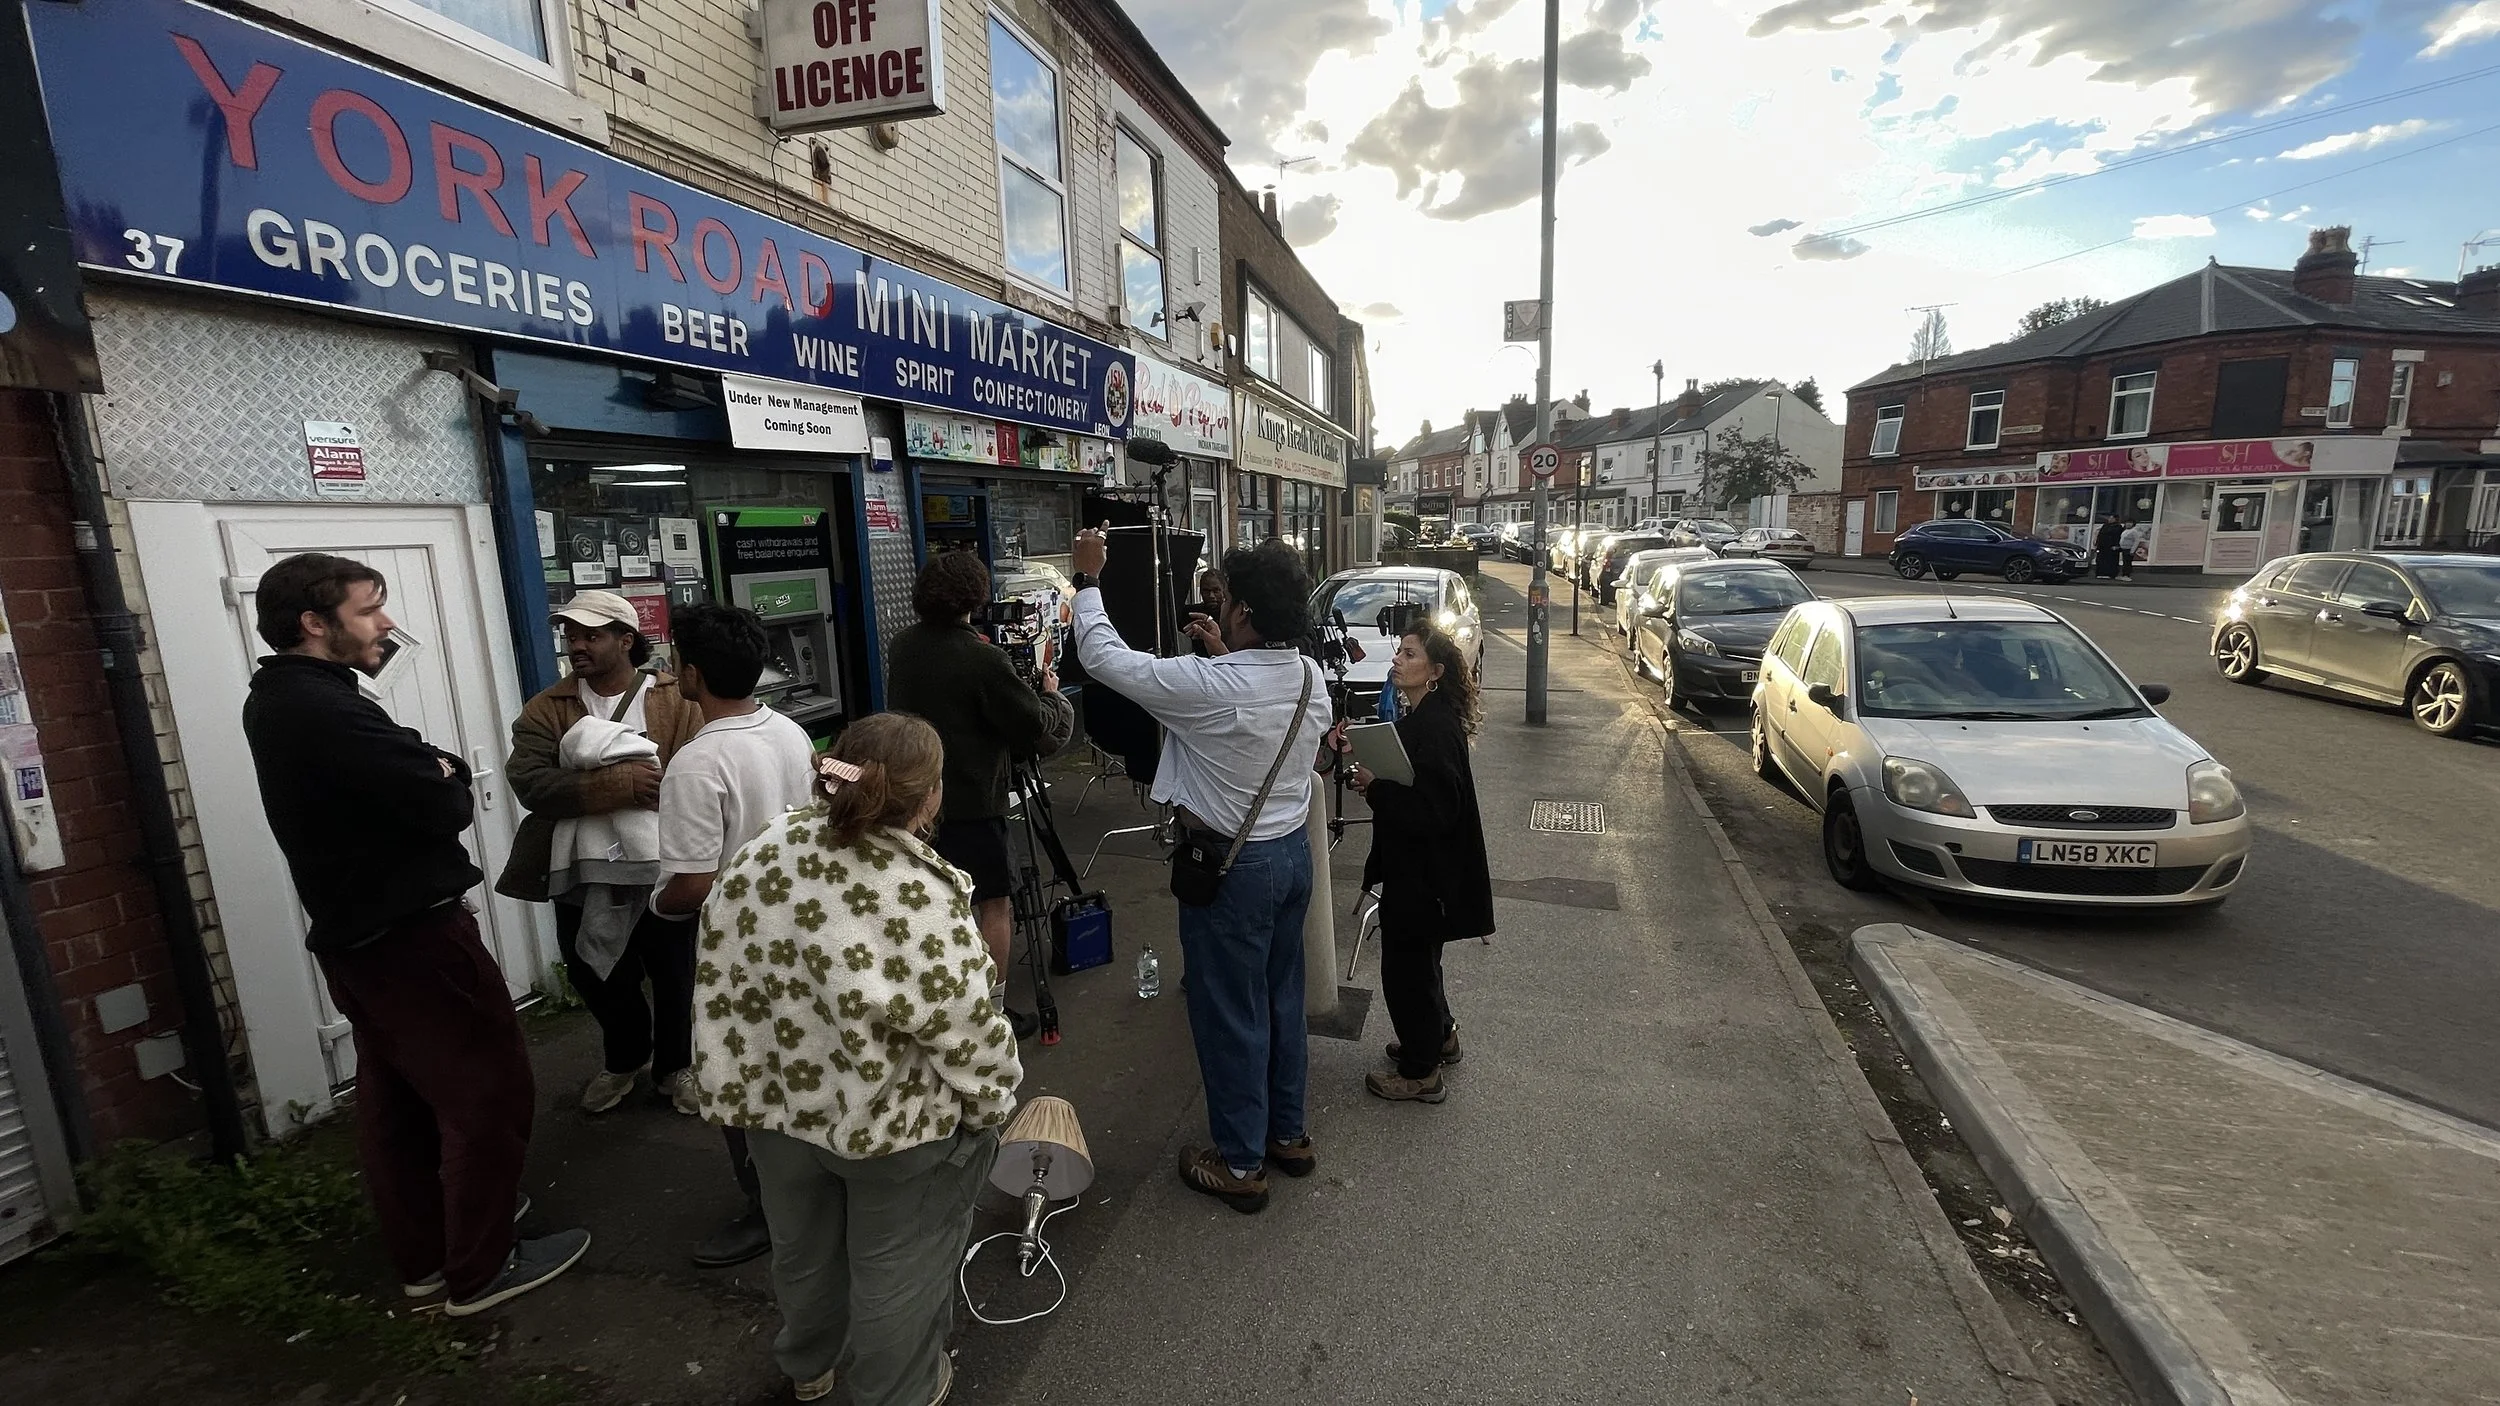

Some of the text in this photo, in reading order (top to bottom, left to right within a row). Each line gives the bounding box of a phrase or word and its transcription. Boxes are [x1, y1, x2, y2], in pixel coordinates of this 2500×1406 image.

[813, 0, 876, 49] OFF
[775, 47, 925, 111] LICENCE
[170, 31, 1092, 390] YORK ROAD MINI MARKET
[124, 228, 185, 276] 37
[247, 208, 1088, 422] GROCERIES BEER WINE SPIRIT CONFECTIONERY
[728, 390, 859, 416] Under New Management
[764, 418, 832, 435] Coming Soon
[1257, 404, 1286, 453] Kings
[309, 436, 356, 445] verisure
[313, 447, 359, 460] Alarm
[1533, 454, 1557, 468] 20
[866, 501, 887, 511] Alarm
[735, 536, 819, 549] cash withdrawals and
[737, 547, 820, 560] free balance enquiries
[2036, 843, 2152, 864] LN58 XKC
